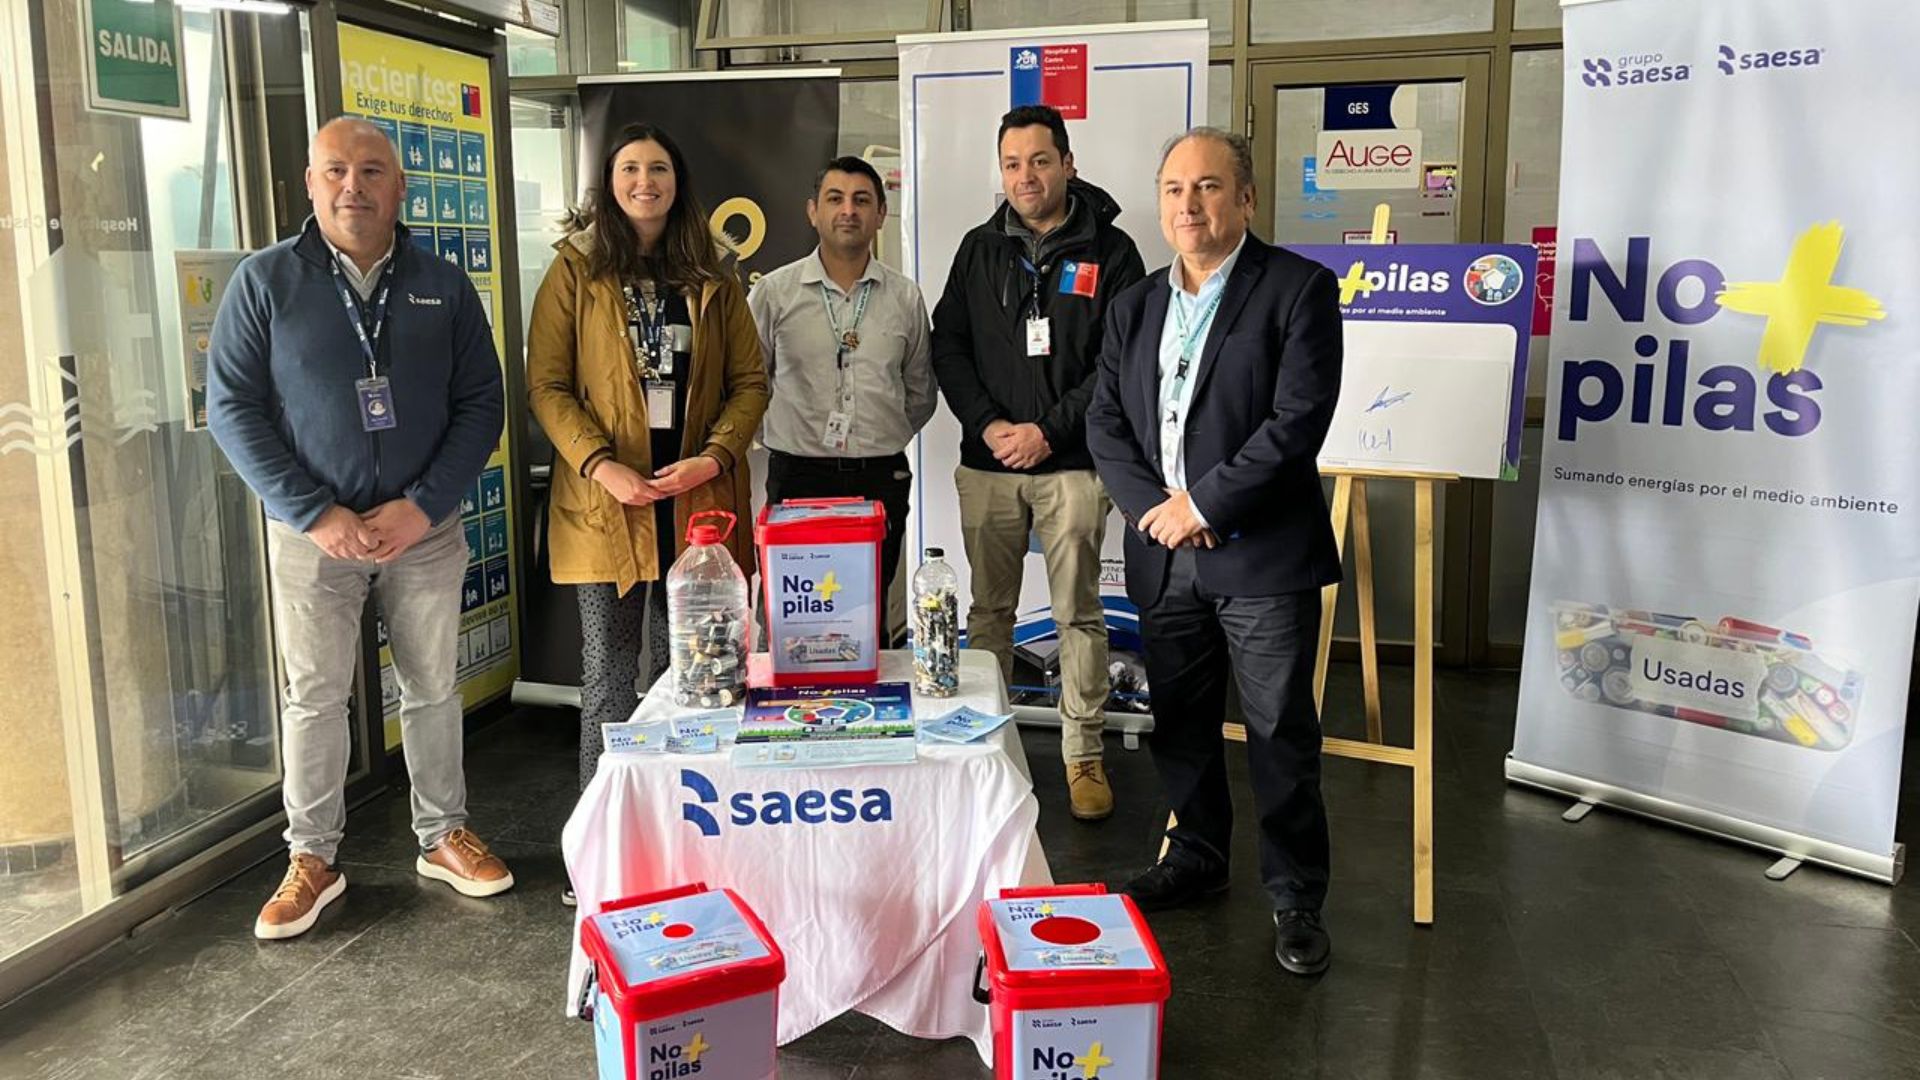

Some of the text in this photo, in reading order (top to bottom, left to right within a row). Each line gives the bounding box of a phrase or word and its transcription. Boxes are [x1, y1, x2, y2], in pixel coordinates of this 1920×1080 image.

[98, 28, 173, 67] SALIDA
[1618, 52, 1663, 69] grupo
[1740, 48, 1821, 70] saesa
[1616, 64, 1690, 85] saesa
[356, 92, 454, 123] Exige tus derechos
[1347, 102, 1369, 114] GES
[1362, 263, 1450, 298] pilas
[1352, 306, 1366, 315] por
[1377, 307, 1404, 315] medio
[1405, 308, 1447, 316] ambiente
[1557, 334, 1824, 442] pilas
[1553, 466, 1899, 514] Sumando energías por el medio ambiente
[782, 594, 834, 618] pilas
[1643, 657, 1745, 699] Usadas
[729, 787, 892, 826] saesa
